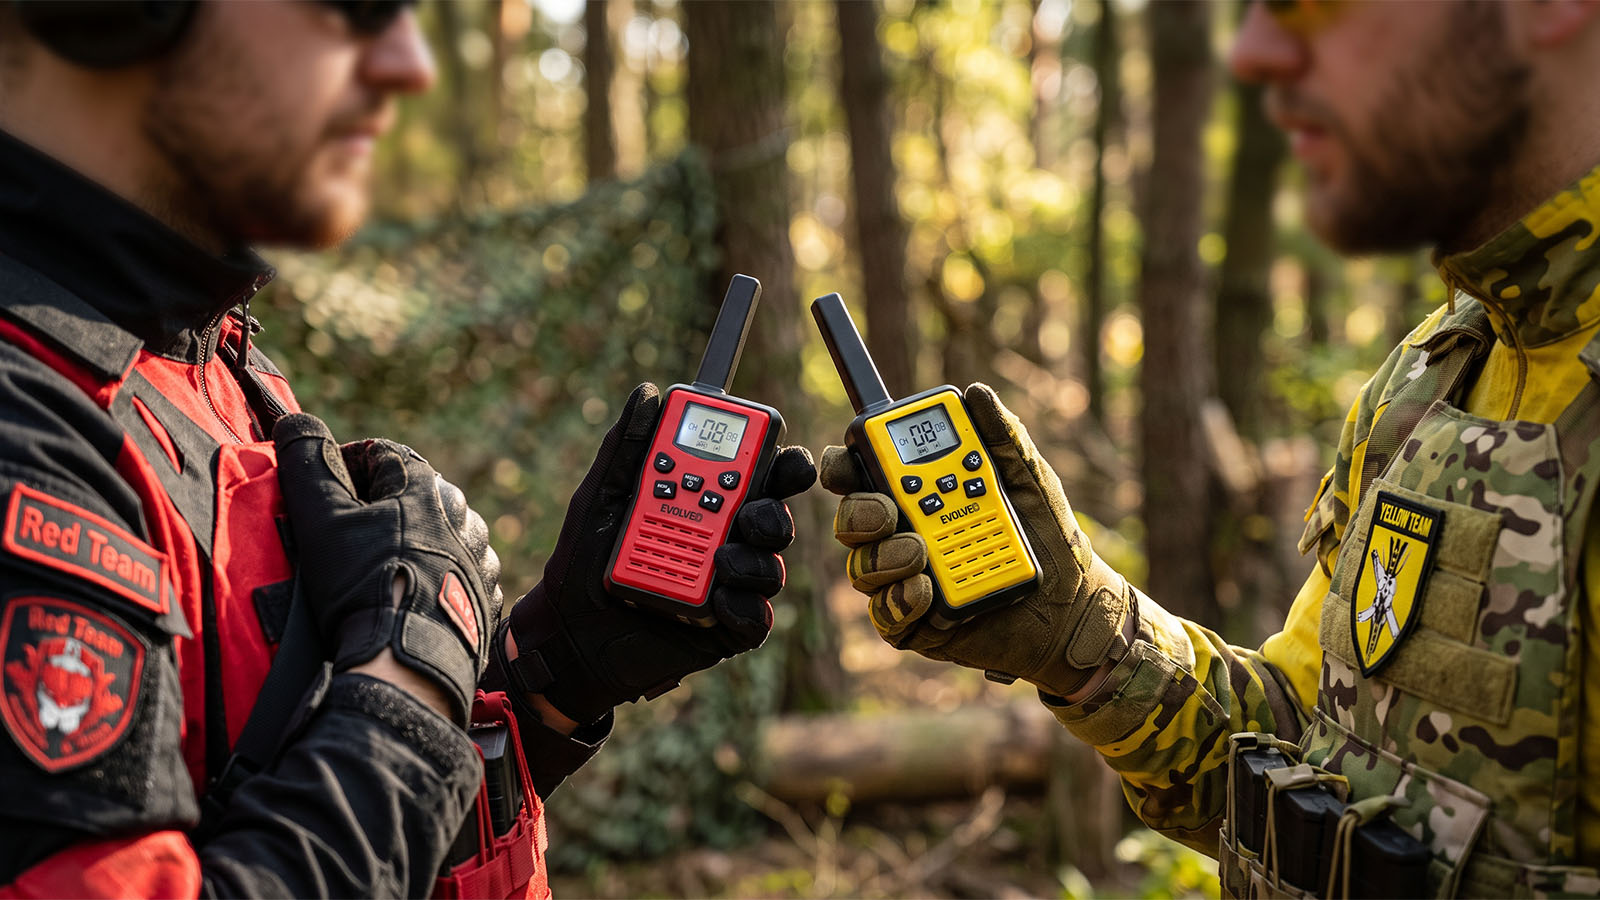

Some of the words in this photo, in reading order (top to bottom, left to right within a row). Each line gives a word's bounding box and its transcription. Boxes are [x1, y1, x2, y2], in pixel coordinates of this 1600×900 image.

[688, 422, 698, 432] CH
[699, 419, 728, 443] 08
[909, 420, 937, 446] 08
[1380, 502, 1411, 529] YELLOW
[1408, 513, 1432, 538] TEAM
[20, 505, 81, 555] Red
[87, 529, 156, 592] Team
